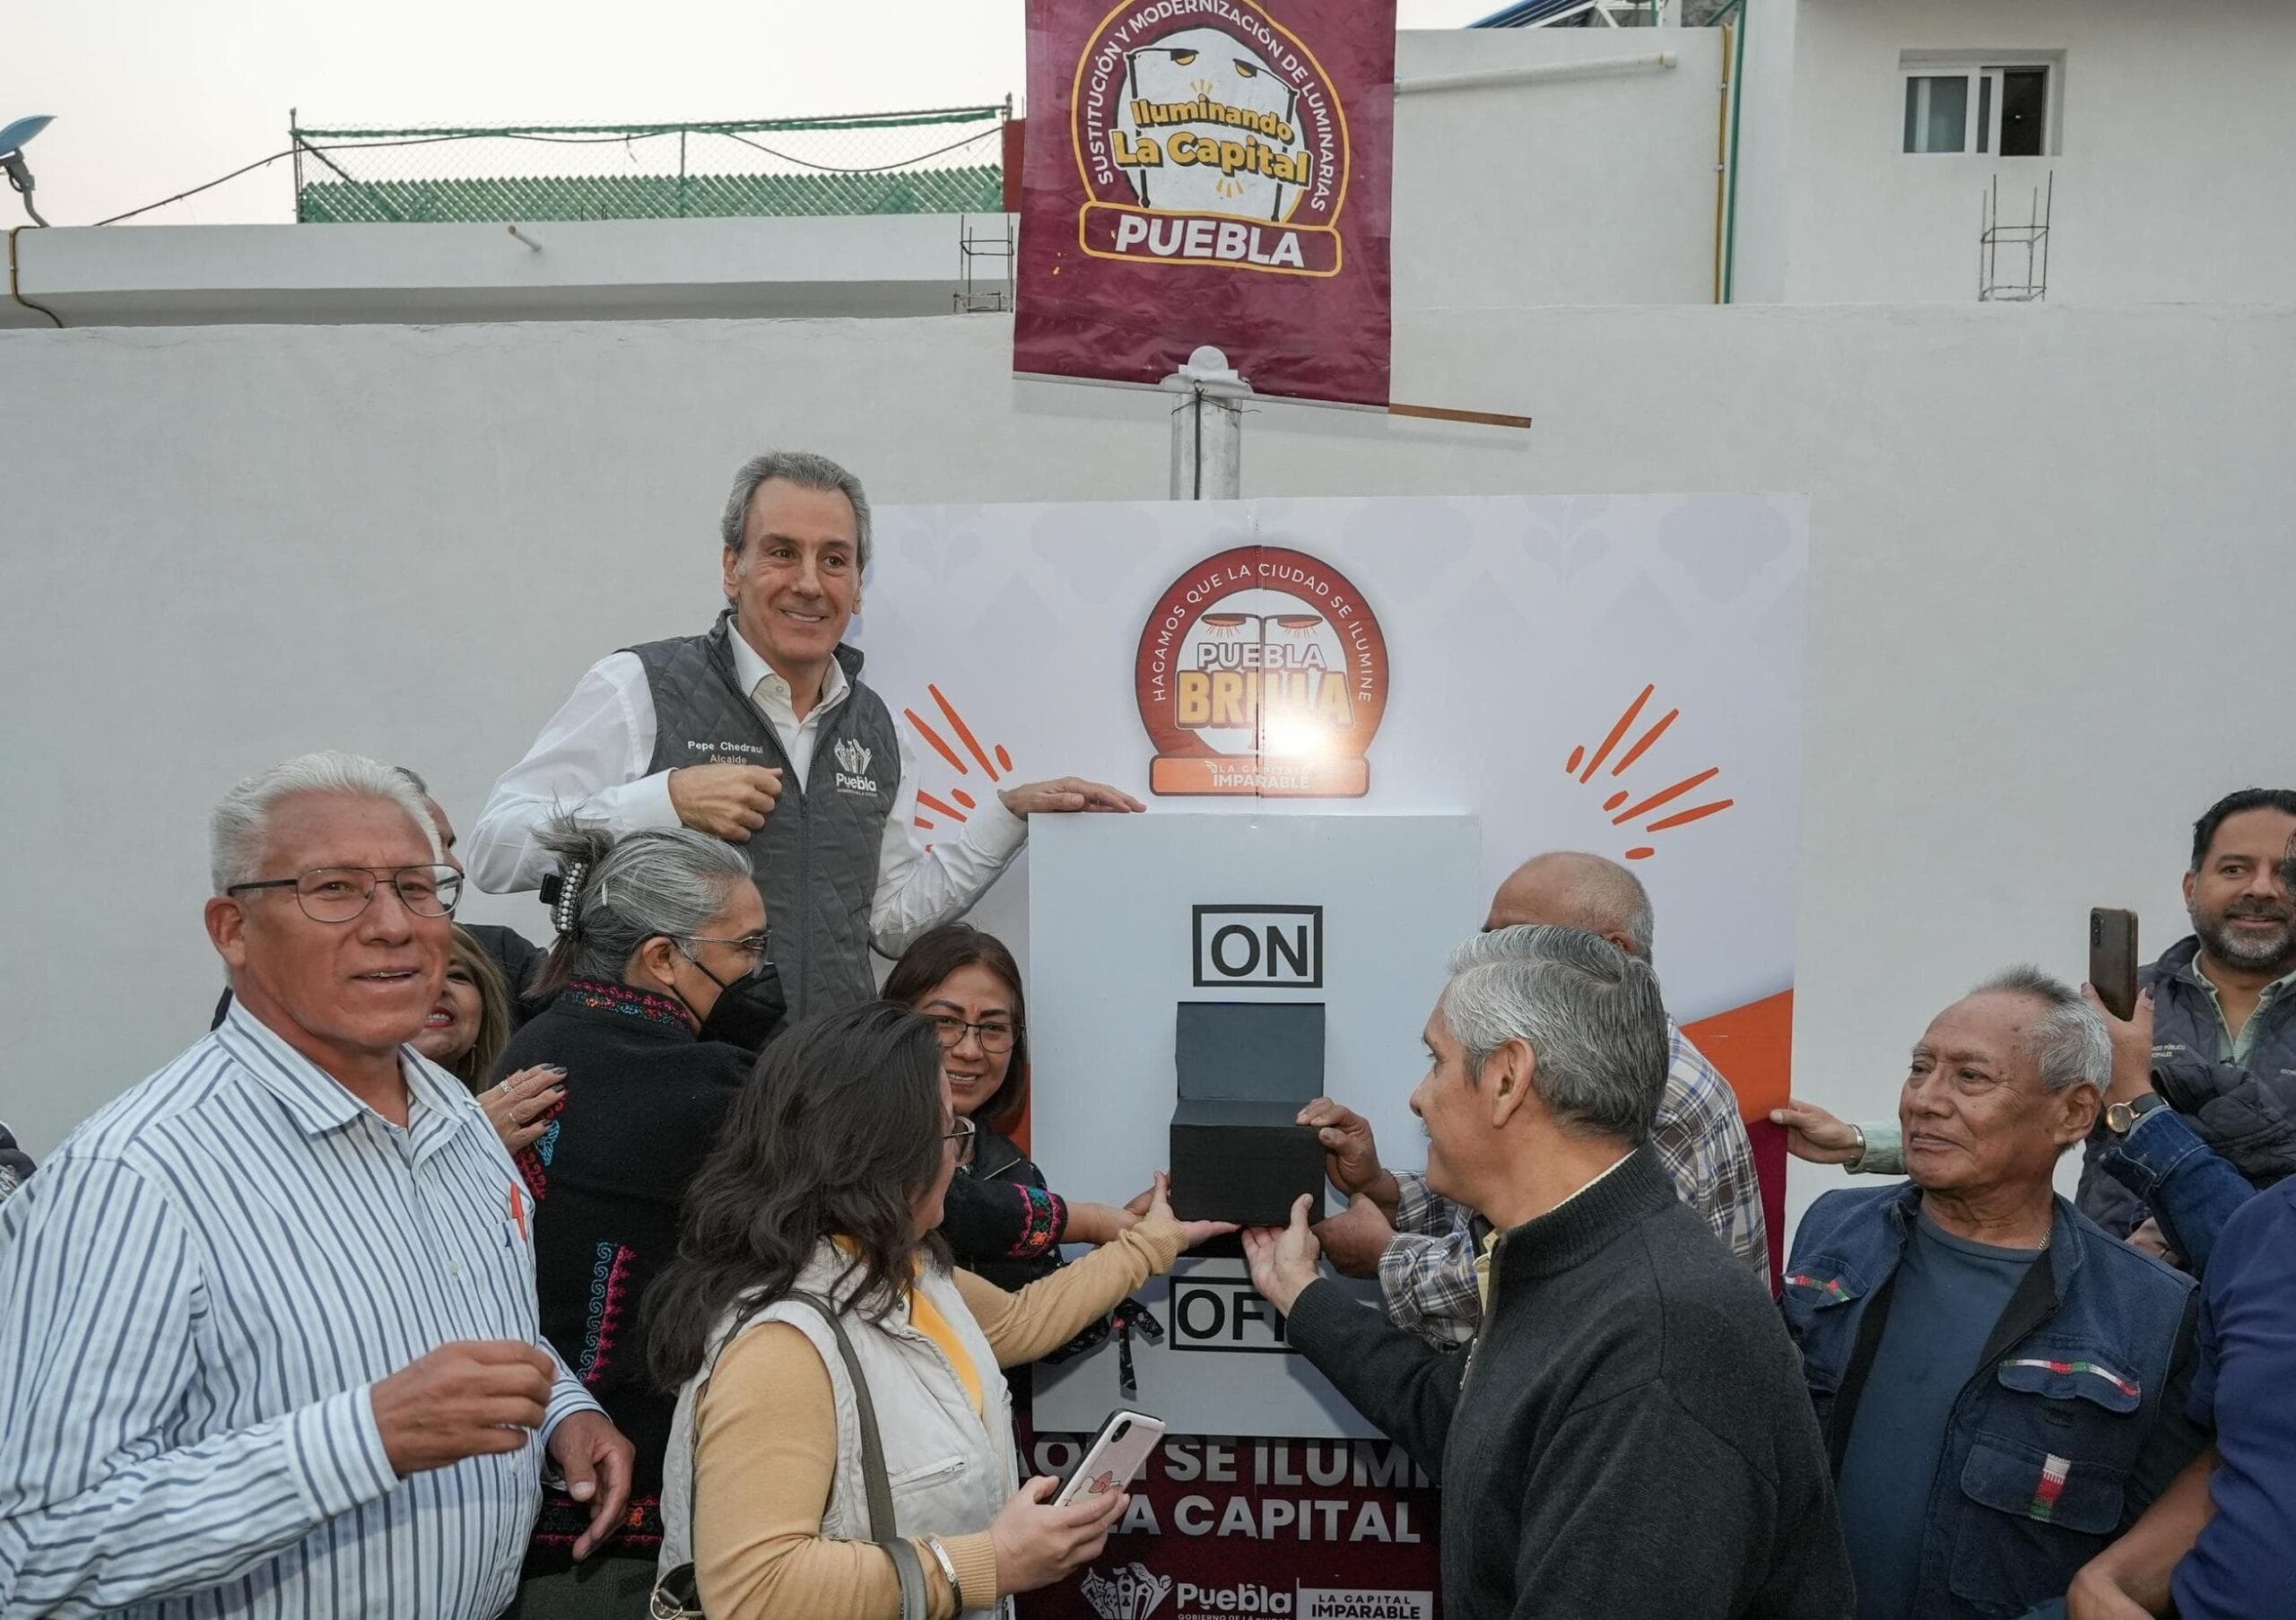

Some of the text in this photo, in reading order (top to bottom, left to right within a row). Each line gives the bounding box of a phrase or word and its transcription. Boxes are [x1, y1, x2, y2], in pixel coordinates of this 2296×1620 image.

[1087, 0, 1335, 213] SUSTITUCIÓN Y MODERNIZACIÓN DE LUMINARIAS
[1130, 93, 1294, 144] Iluminando
[1111, 130, 1311, 187] La Capital
[1115, 213, 1305, 267] PUEBLA
[1151, 563, 1374, 702] HAGAMOS QUE LA CIUDAD SE ILUMINE
[1197, 642, 1328, 670] PUEBLA
[687, 740, 715, 753] Pepe
[709, 753, 747, 764] Alcalde
[835, 771, 877, 792] Puebla
[1213, 773, 1310, 789] IMPARABLE
[1211, 924, 1308, 977] ON
[1164, 1435, 1237, 1482] SE
[1109, 1494, 1421, 1543] A CAPITAL
[1177, 1582, 1292, 1614] Puebla
[1311, 1604, 1421, 1620] IMPARABLE
[1318, 1594, 1412, 1606] LA CAPITAL
